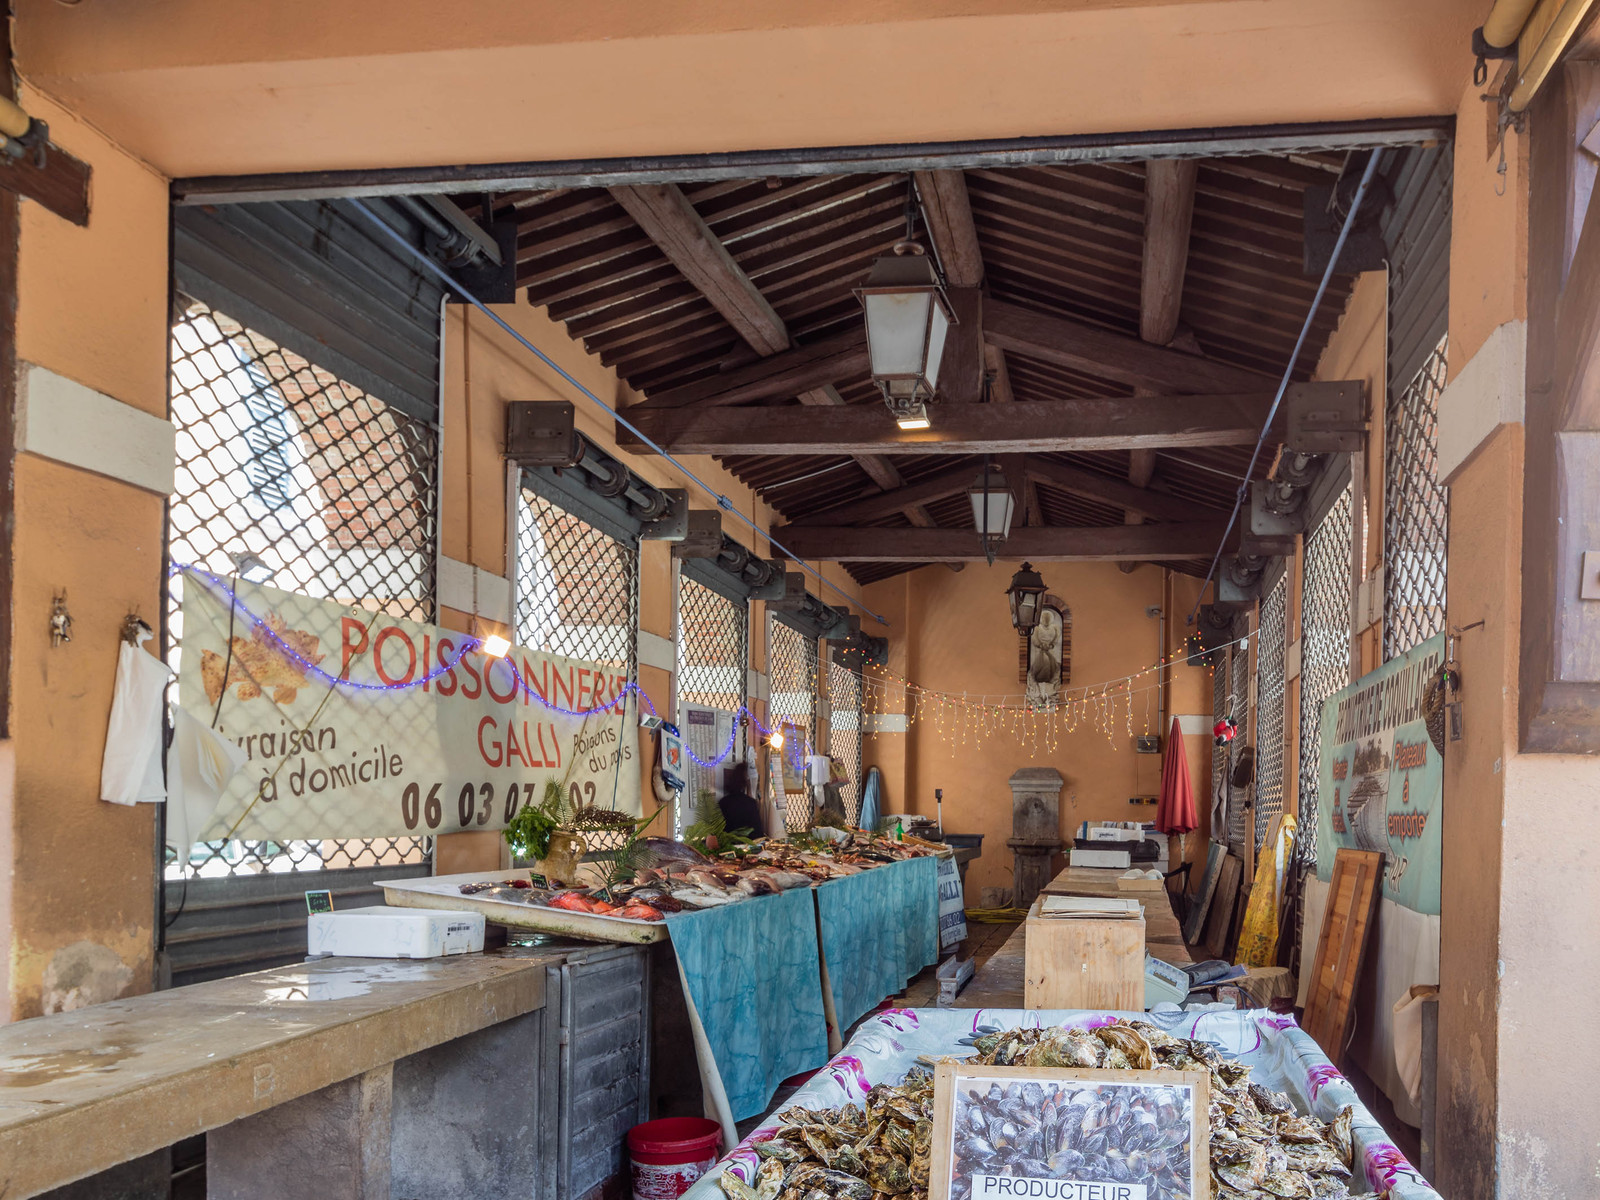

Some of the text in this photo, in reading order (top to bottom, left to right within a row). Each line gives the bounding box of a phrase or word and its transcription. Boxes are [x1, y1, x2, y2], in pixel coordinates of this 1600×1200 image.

[341, 617, 627, 715] POISSONNERIE
[477, 714, 561, 768] GALLI
[589, 750, 607, 773] du
[259, 744, 403, 803] à domicile
[402, 782, 443, 830] 06
[458, 782, 495, 827] 03
[1387, 809, 1430, 845] emporte
